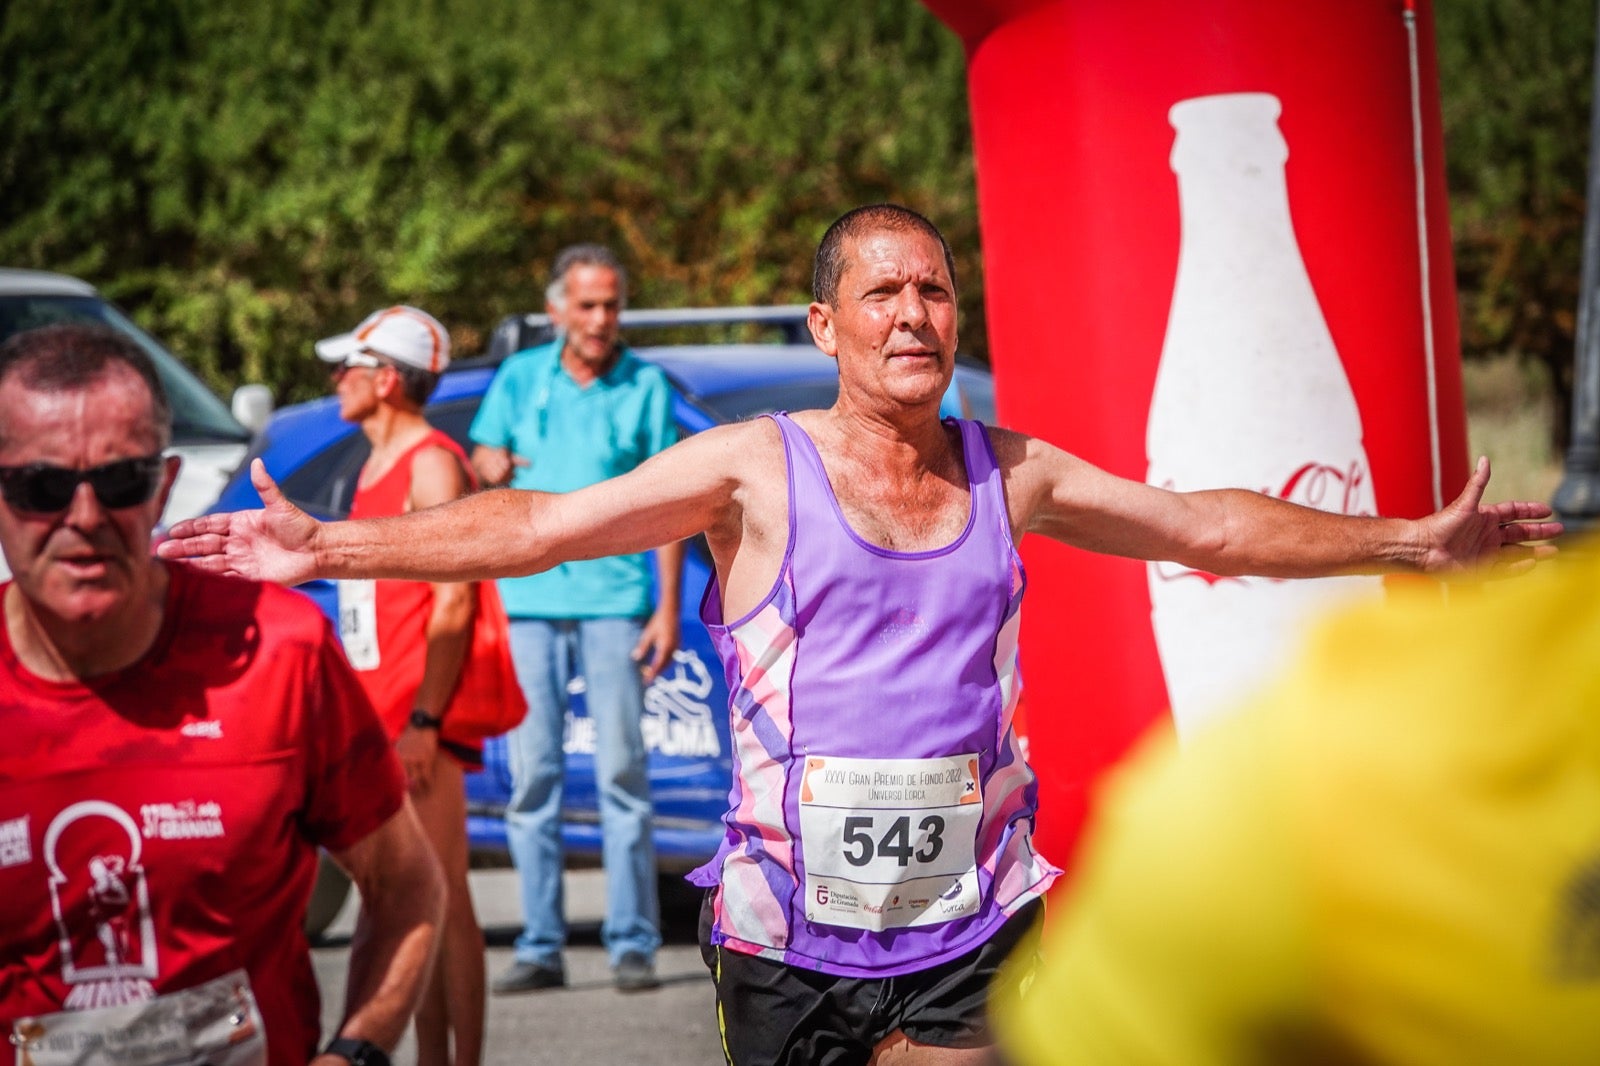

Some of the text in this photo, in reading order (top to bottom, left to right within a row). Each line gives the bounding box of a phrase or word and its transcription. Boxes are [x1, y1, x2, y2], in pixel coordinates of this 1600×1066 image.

[824, 767, 962, 786] XXXV GRAN PREMIO DE FONDO 2022
[868, 788, 926, 801] UNIVERSO LORCA
[843, 815, 945, 867] 543
[830, 891, 858, 901] Diputación
[836, 899, 859, 908] Granada
